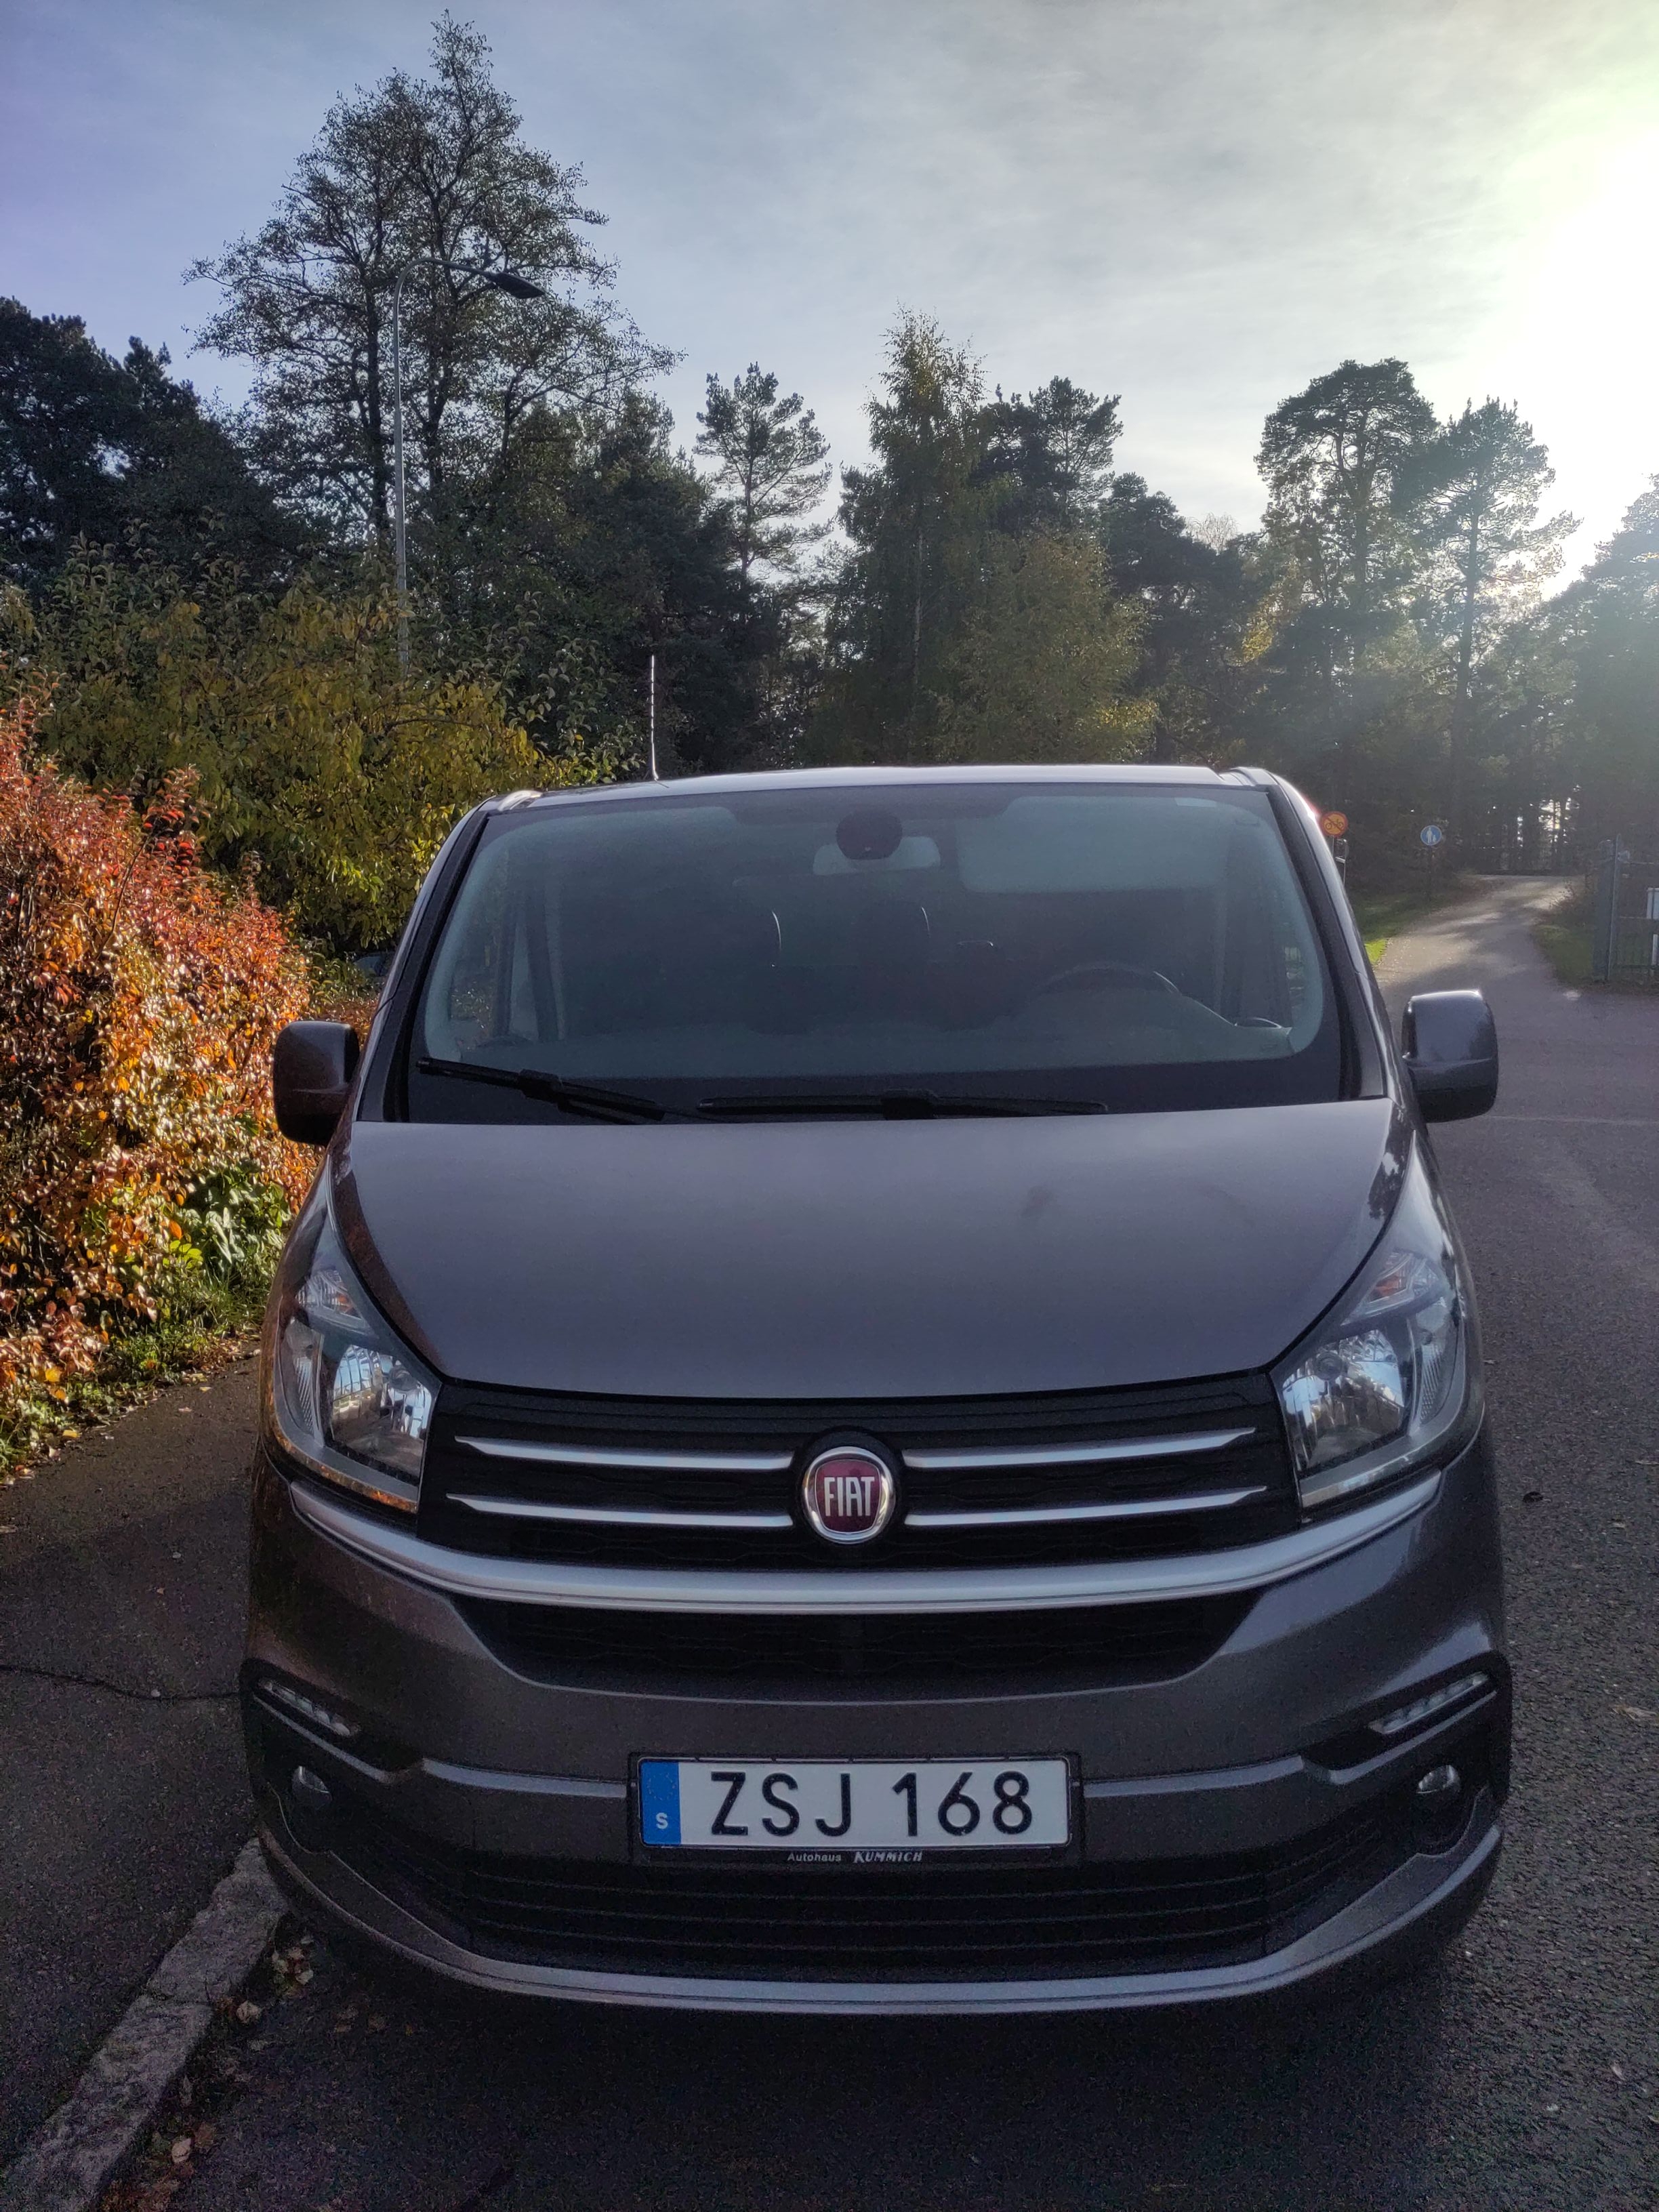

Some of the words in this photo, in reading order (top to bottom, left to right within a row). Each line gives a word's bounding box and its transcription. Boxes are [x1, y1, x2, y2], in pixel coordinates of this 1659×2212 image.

[823, 1477, 875, 1517] FIAT
[710, 1771, 851, 1837] ZSJ
[892, 1771, 1033, 1837] 168
[655, 1812, 668, 1829] S
[787, 1852, 842, 1862] Autohaus
